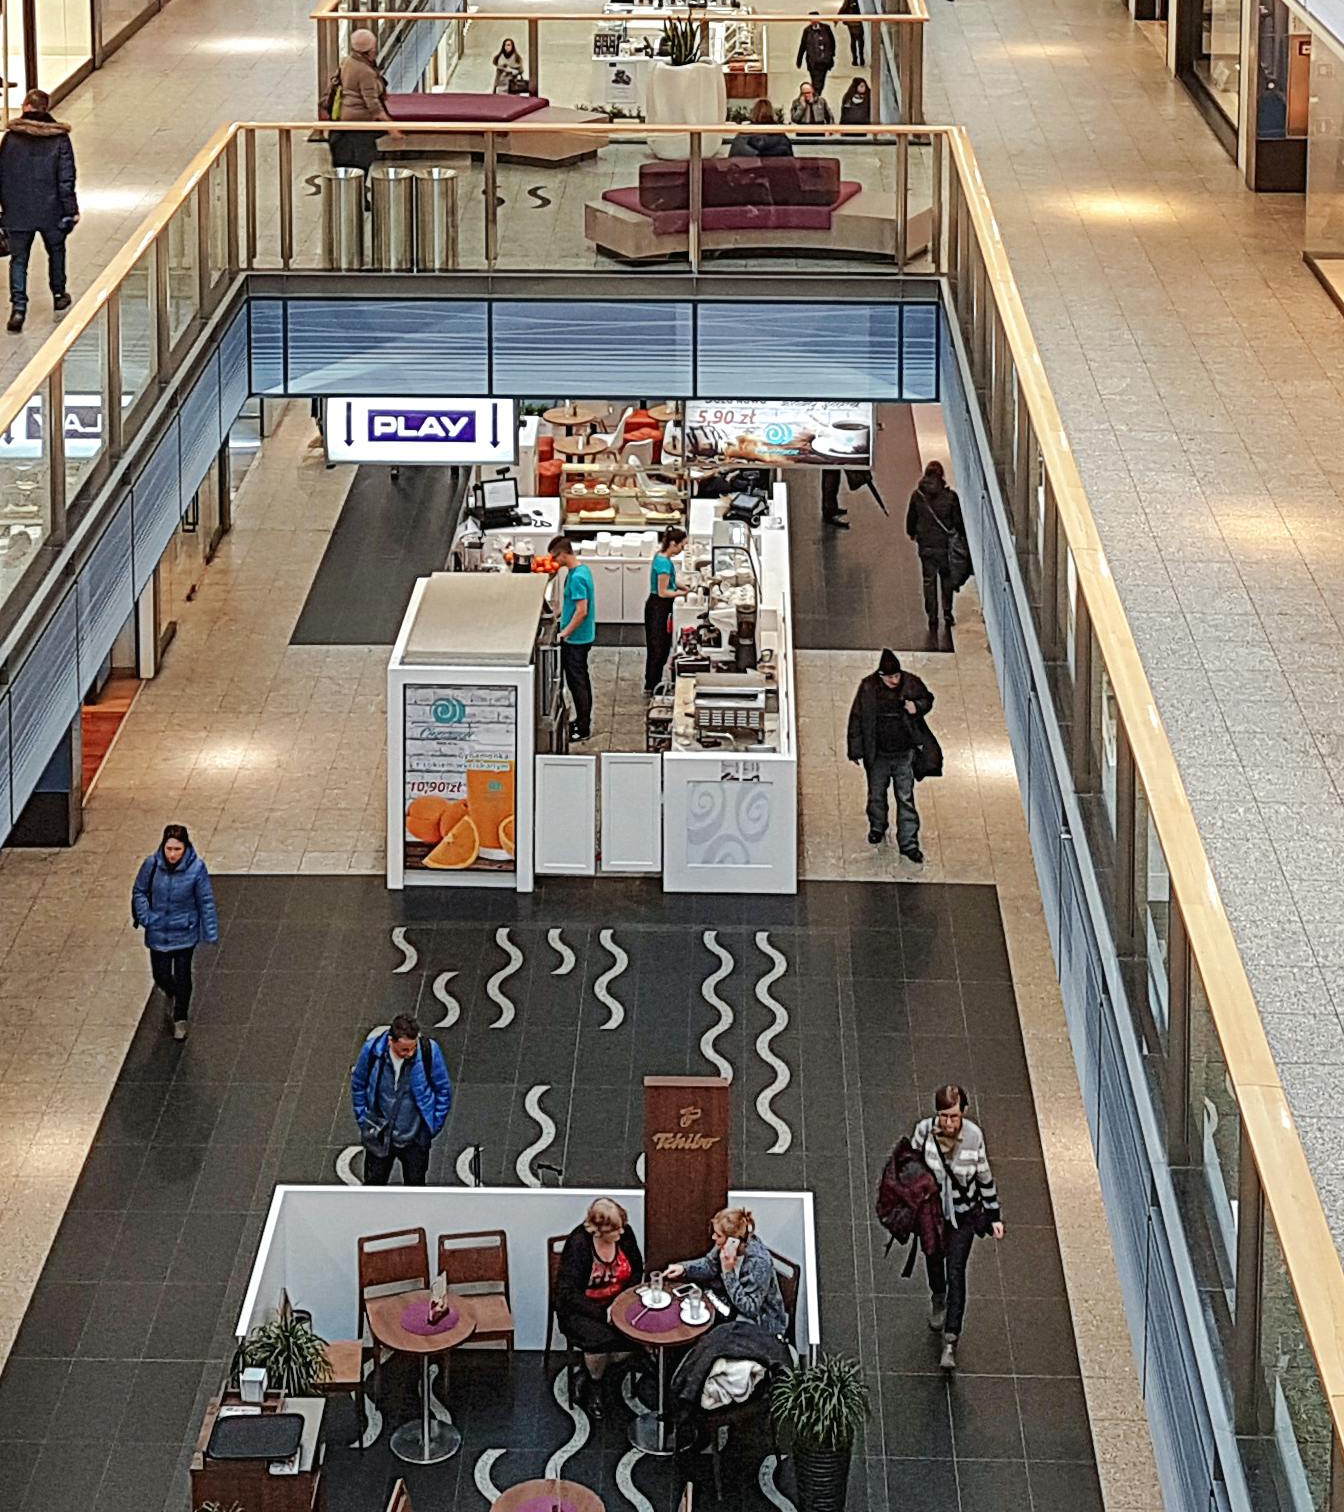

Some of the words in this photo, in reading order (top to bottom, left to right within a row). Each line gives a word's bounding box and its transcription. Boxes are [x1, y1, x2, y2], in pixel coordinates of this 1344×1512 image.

[373, 415, 469, 438] PLAY
[698, 409, 735, 427] 5,90
[410, 781, 446, 794] 10,90
[652, 1131, 721, 1150] Tchibo
